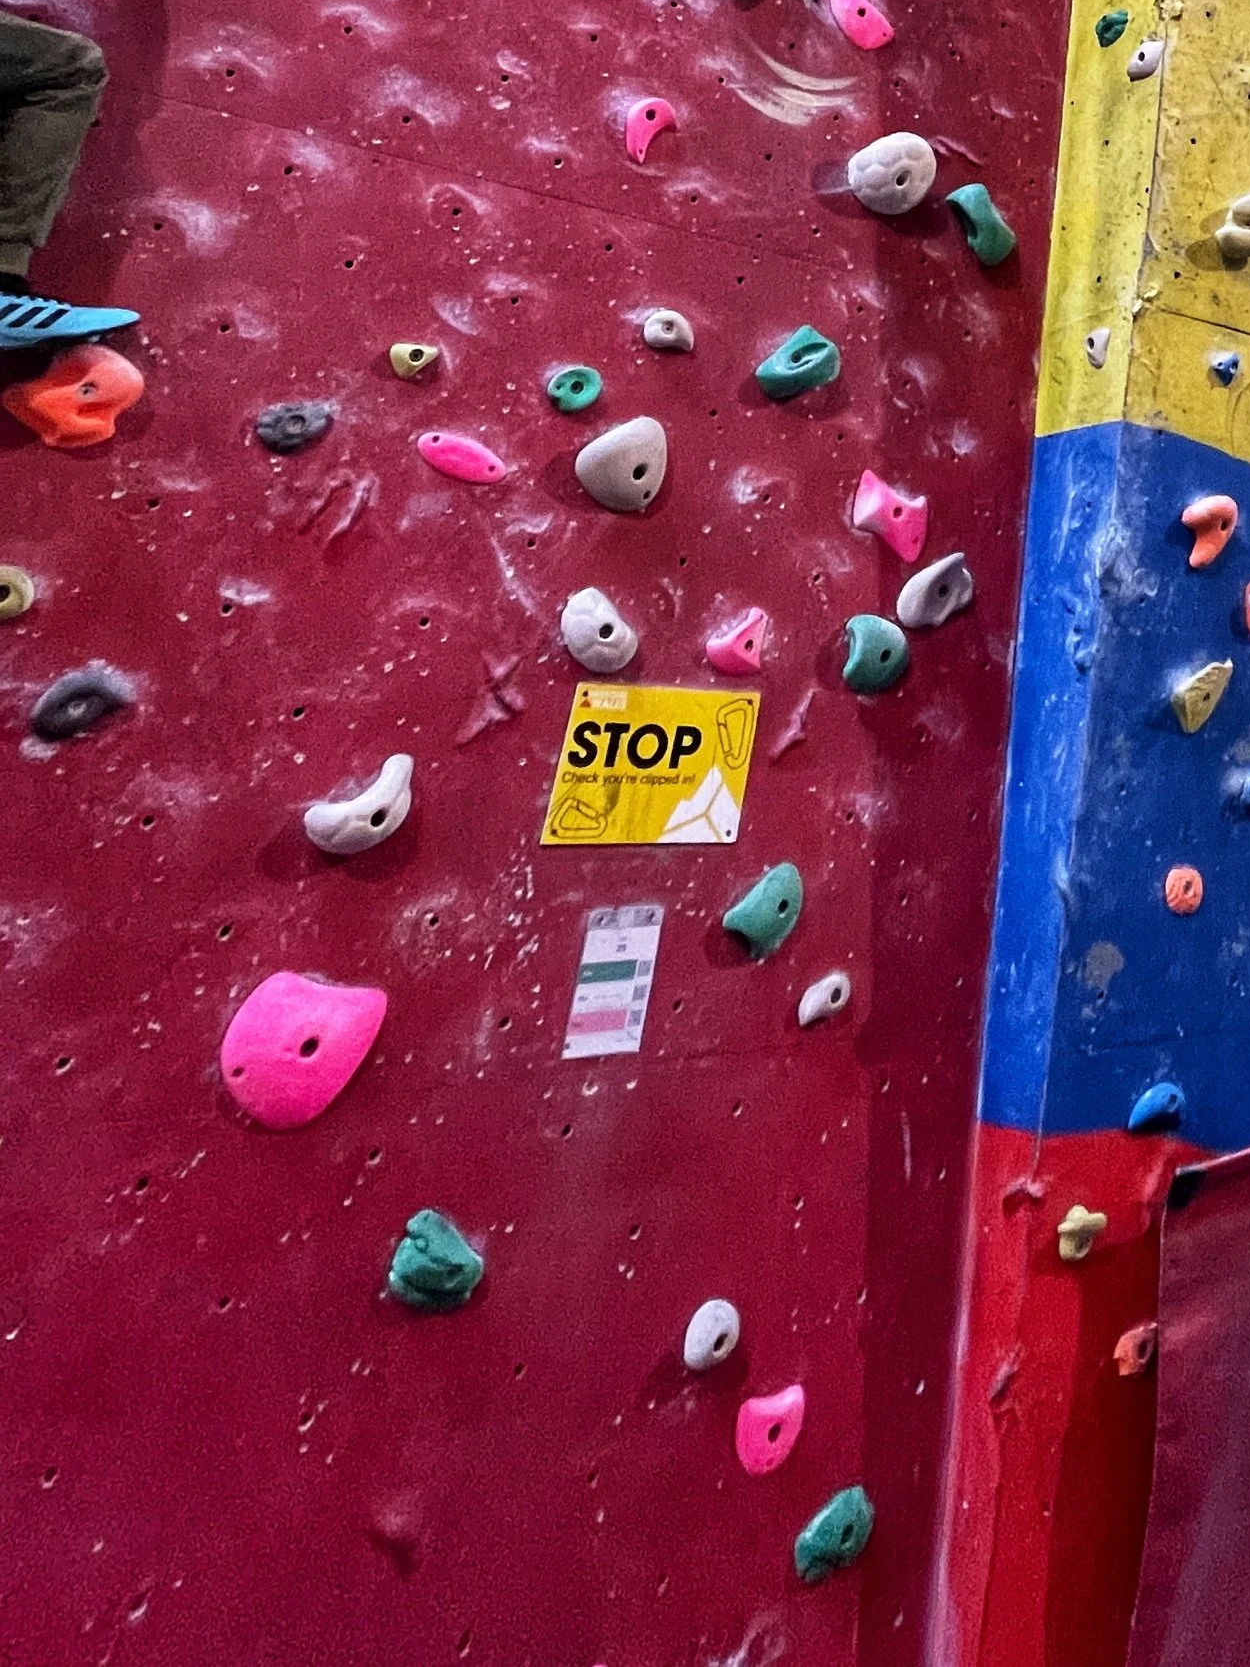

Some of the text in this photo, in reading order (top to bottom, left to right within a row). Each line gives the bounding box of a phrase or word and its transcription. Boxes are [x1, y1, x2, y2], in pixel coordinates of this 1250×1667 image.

[568, 721, 702, 769] STOP
[561, 771, 598, 784] Check
[602, 772, 637, 786] you're
[640, 773, 679, 786] clipped
